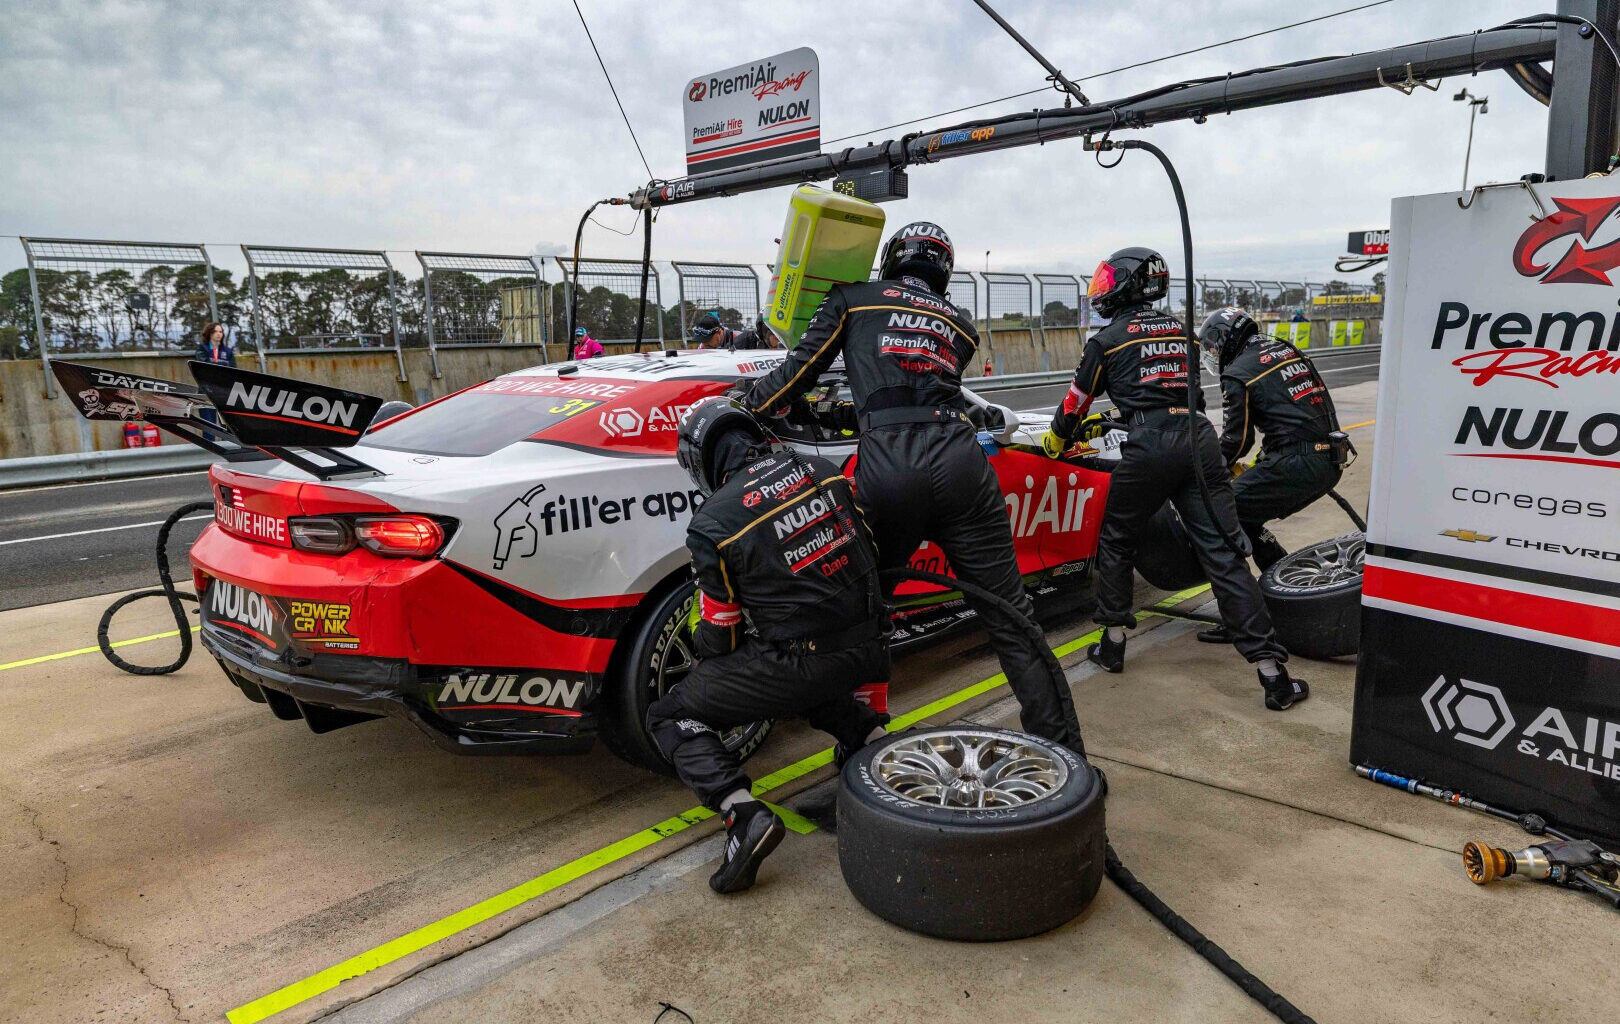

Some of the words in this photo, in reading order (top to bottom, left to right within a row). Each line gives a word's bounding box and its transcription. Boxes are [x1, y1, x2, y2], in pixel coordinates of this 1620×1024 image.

[709, 62, 777, 99] PremiAir
[752, 70, 813, 101] Racing
[758, 99, 809, 126] NULON
[693, 121, 725, 138] PremiAir
[727, 118, 742, 131] Hire
[971, 126, 995, 141] app
[676, 182, 695, 192] AIR
[902, 291, 959, 317] PremiAir
[887, 312, 957, 343] NULON
[1431, 298, 1620, 351] Premi
[881, 335, 938, 352] PremiAir
[1141, 342, 1188, 359] NULON
[94, 371, 174, 393] DAYCO
[1140, 362, 1180, 377] PremiAir
[550, 382, 636, 398] HIRE
[226, 381, 360, 428] NULON
[549, 398, 597, 417] 31
[1454, 405, 1620, 456] NULO
[540, 495, 637, 537] fill'er
[643, 488, 704, 522] app
[1451, 487, 1607, 518] coregas
[233, 508, 251, 534] WE
[253, 514, 285, 541] HIRE
[783, 527, 834, 566] PremiAir
[1506, 537, 1620, 562] CHEVRO
[211, 578, 275, 636] NULON
[291, 601, 351, 620] POWER
[324, 641, 359, 649] BATTERIES
[438, 674, 584, 709] NULON
[1517, 739, 1540, 758] &
